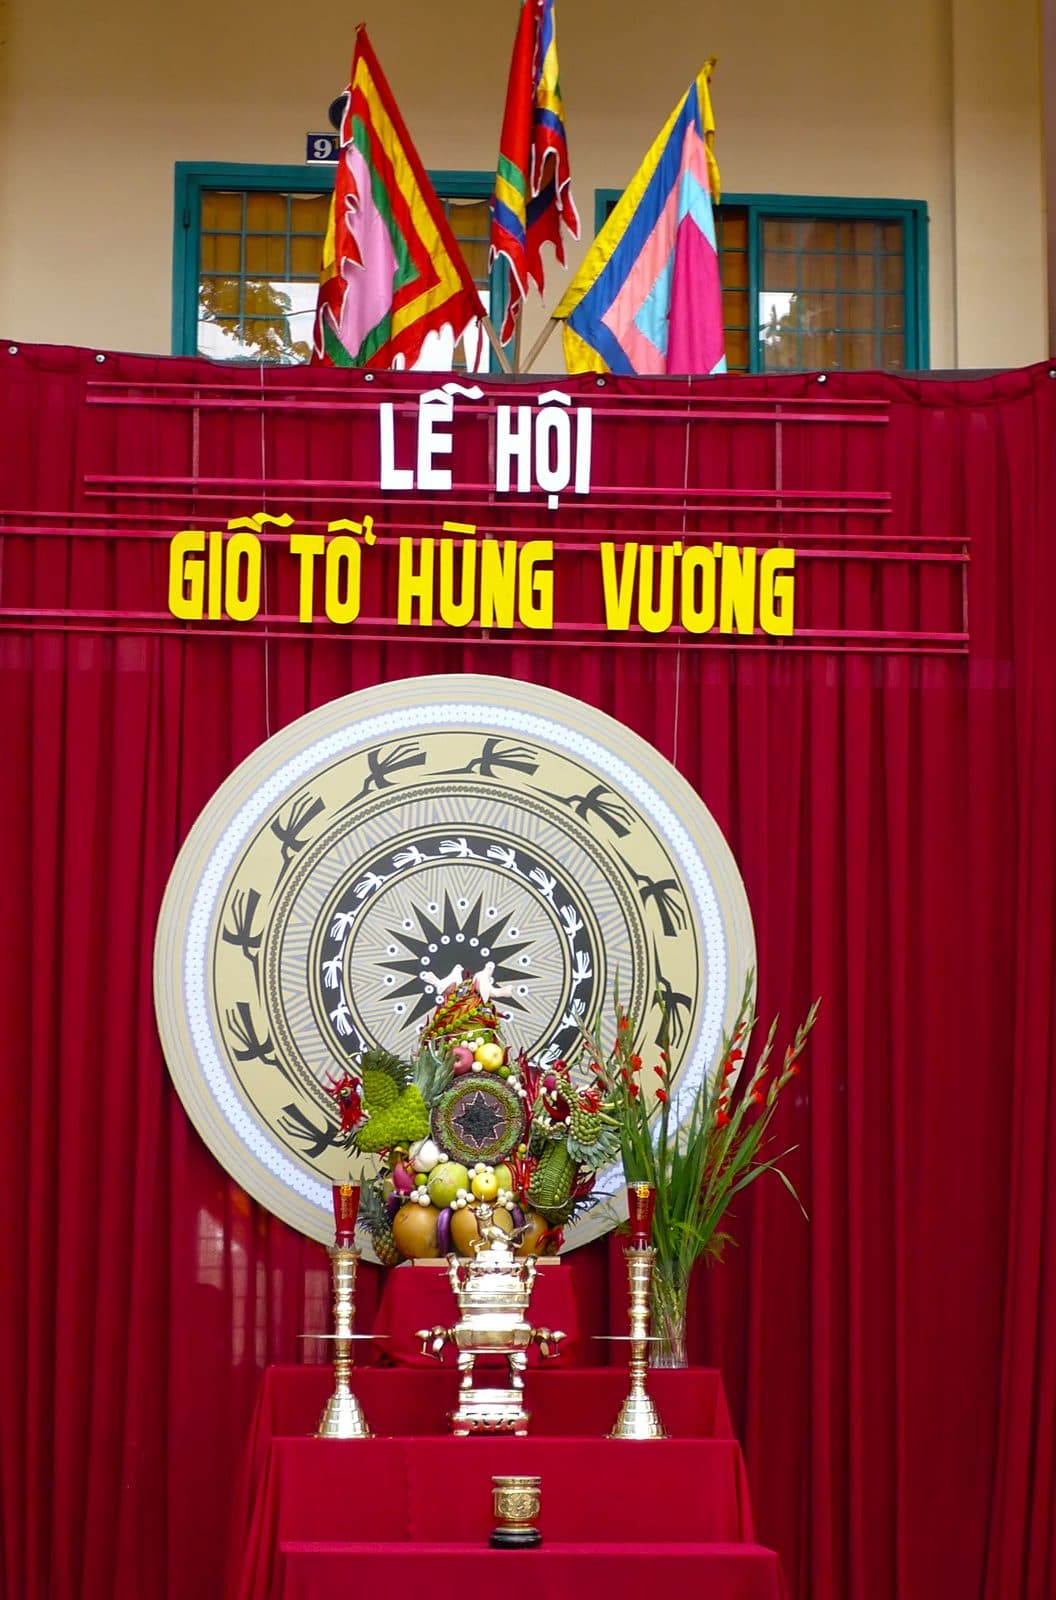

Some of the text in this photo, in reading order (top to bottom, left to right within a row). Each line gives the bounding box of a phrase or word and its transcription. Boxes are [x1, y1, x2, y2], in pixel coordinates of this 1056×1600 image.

[379, 382, 593, 510] LỄ HỘI
[168, 512, 795, 636] GIỖ TỔ HÙNG VƯƠNG
